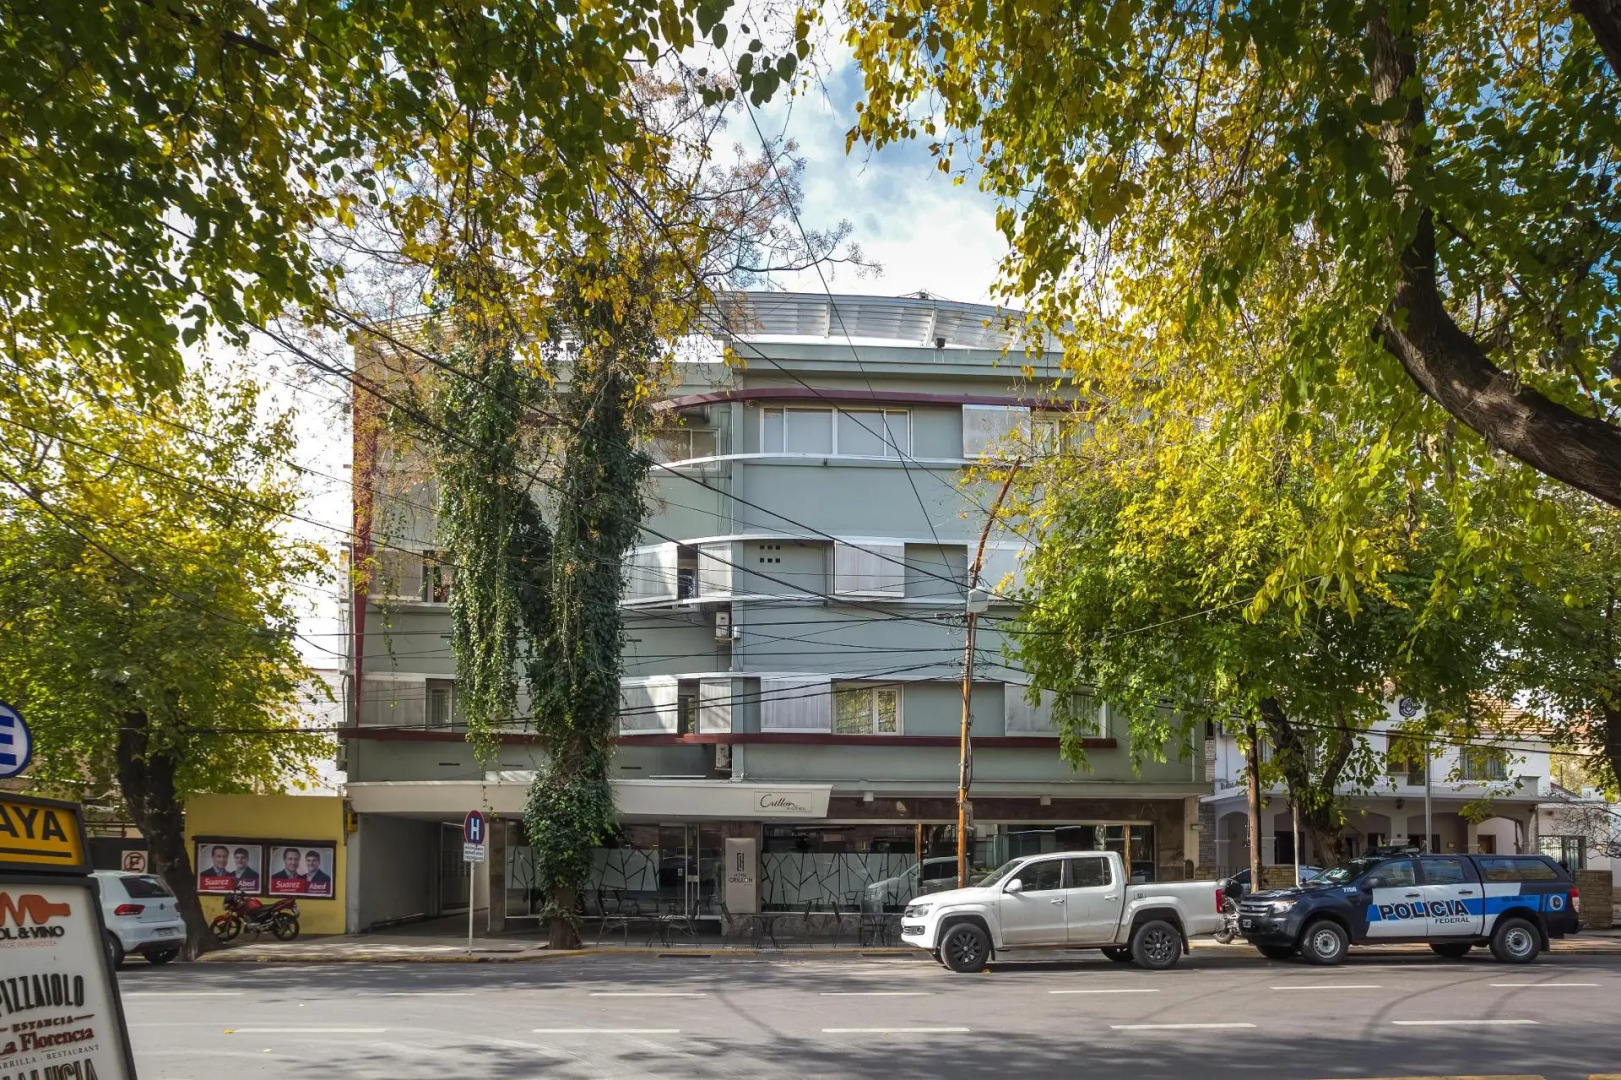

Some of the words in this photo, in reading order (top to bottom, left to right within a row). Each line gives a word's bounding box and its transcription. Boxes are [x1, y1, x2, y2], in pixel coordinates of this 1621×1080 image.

[471, 818, 480, 840] H
[205, 878, 229, 886] Suarez
[275, 881, 300, 889] Suarez
[1378, 900, 1470, 920] POLICIA
[0, 973, 84, 1017] IZZAIOLO
[12, 1015, 75, 1033] ESTANCIA
[18, 1027, 95, 1052] Florencia
[46, 1044, 99, 1060] RESTAURANT
